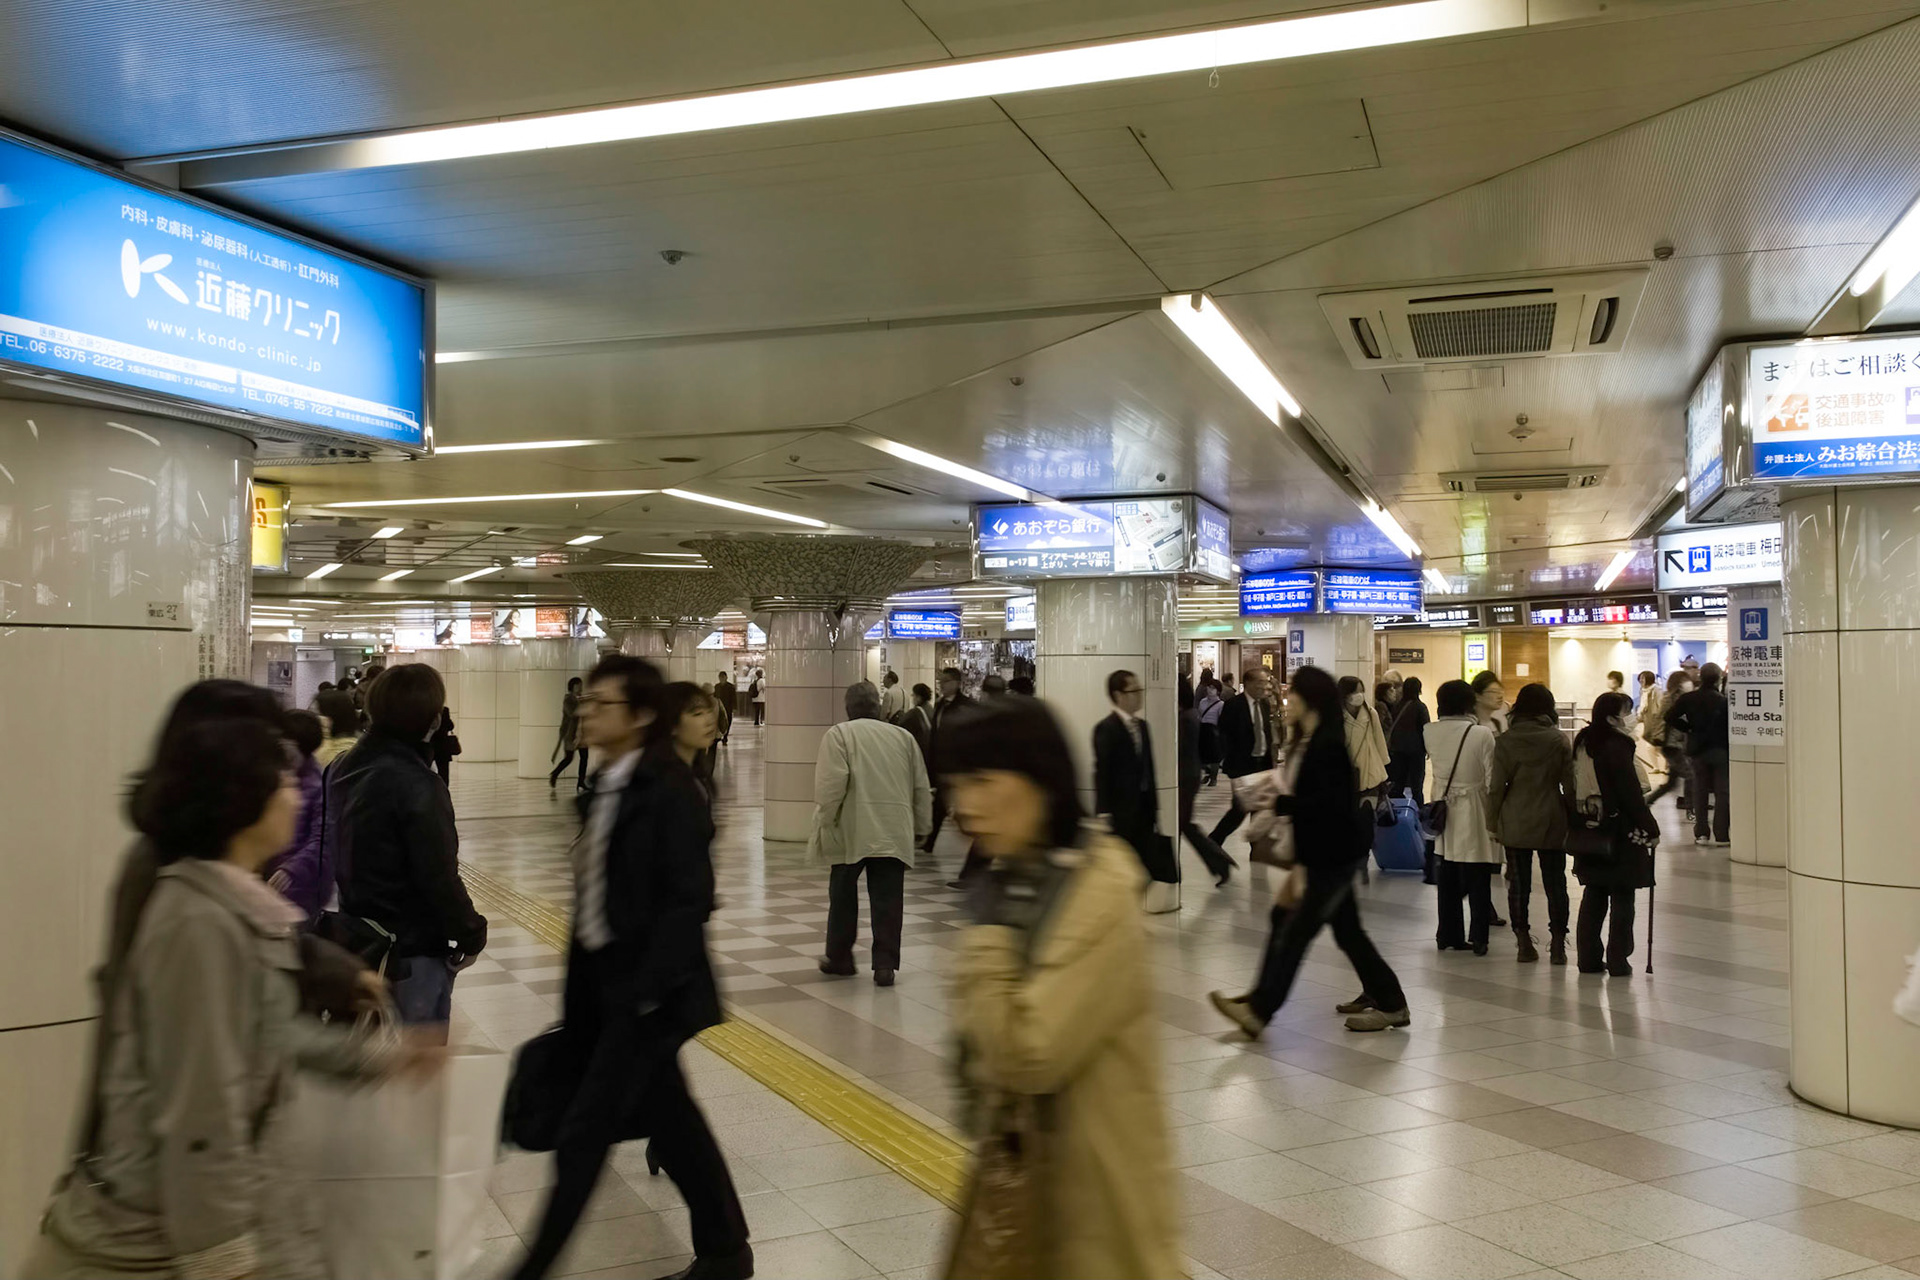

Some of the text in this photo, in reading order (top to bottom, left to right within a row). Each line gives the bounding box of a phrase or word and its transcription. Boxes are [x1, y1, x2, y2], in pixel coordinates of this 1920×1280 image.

[195, 271, 340, 345] 近藤クリニック
[146, 318, 322, 373] www.kondo-clinic.jp
[1816, 411, 1885, 428] 後遺障害
[1764, 453, 1815, 464] 弁護士法人
[1013, 518, 1101, 536] あおぞら銀行
[1714, 542, 1756, 558] 阪神電車
[1732, 712, 1760, 721] Umeda
